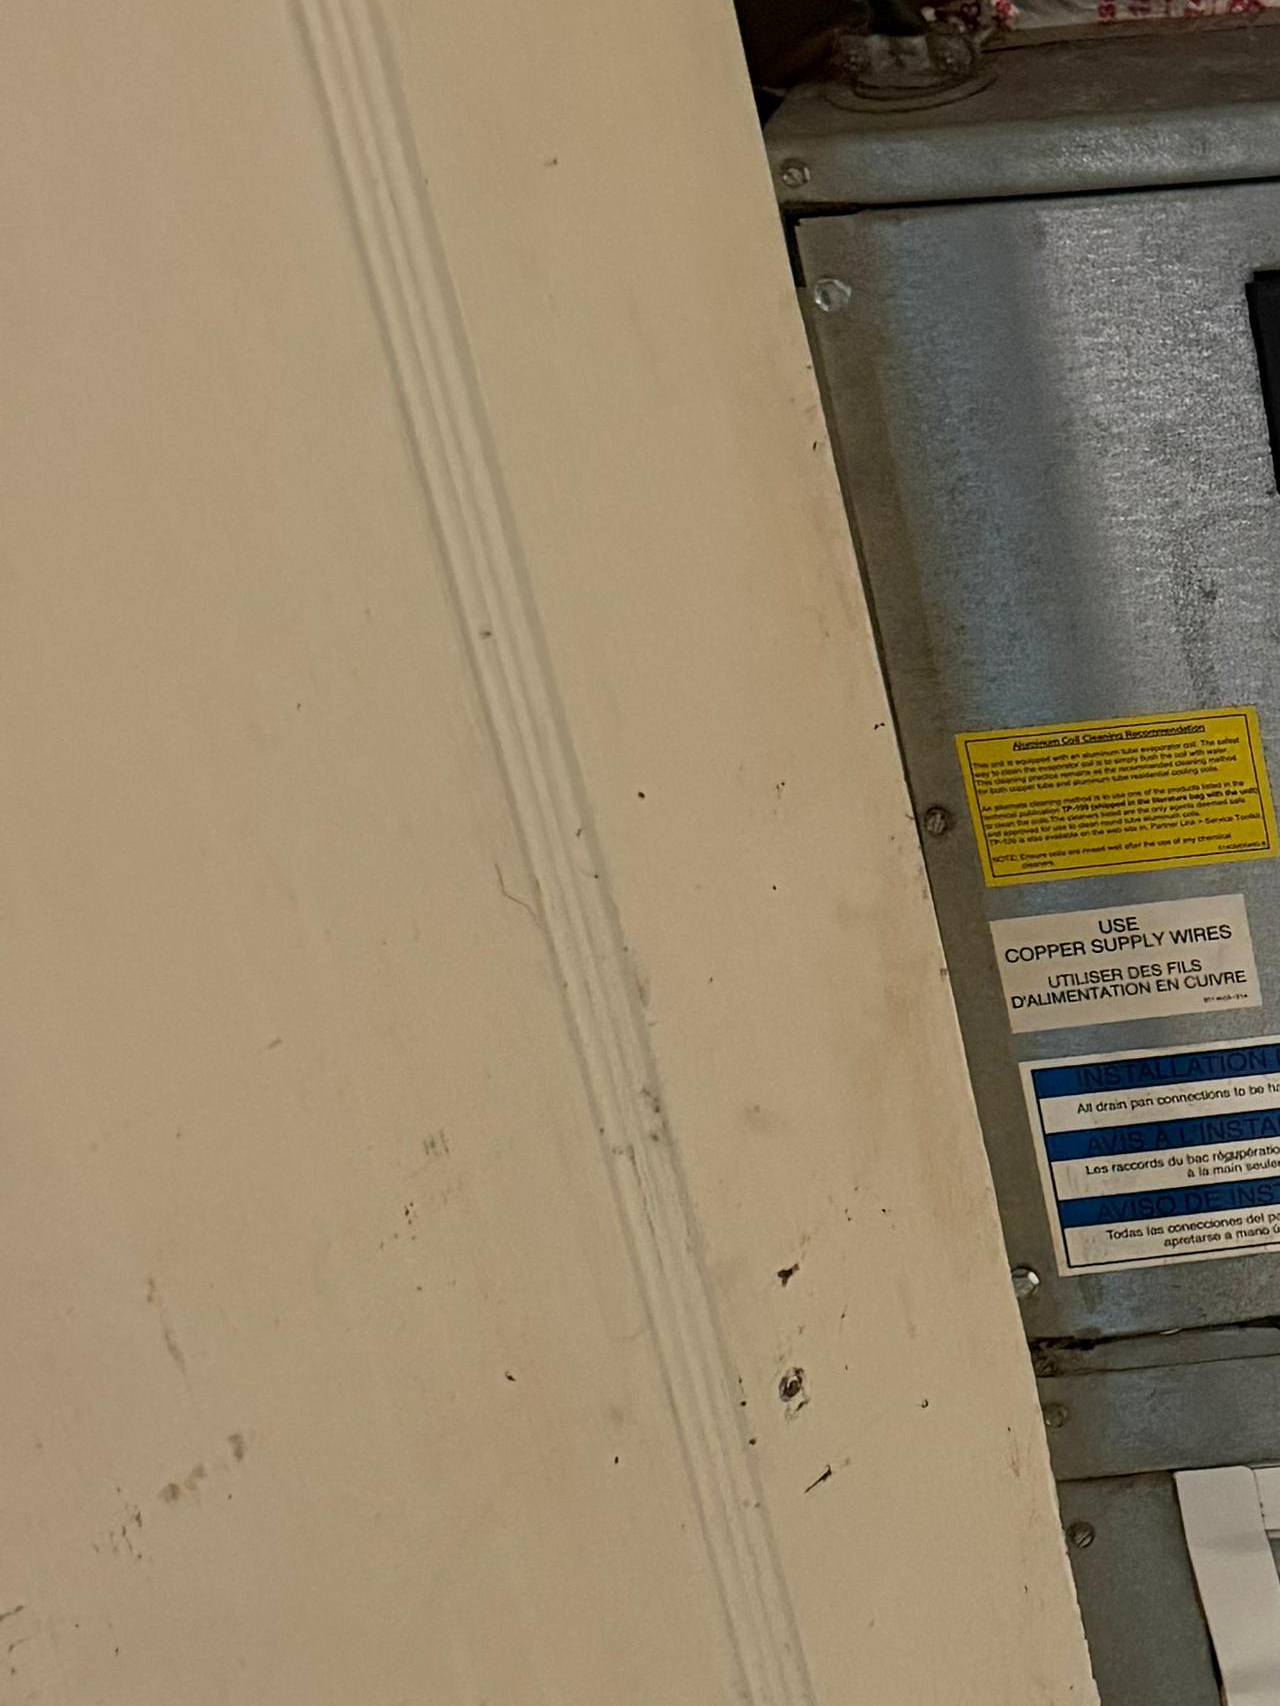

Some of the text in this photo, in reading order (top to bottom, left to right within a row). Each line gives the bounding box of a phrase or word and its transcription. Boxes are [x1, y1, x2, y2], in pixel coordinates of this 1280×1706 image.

[1097, 915, 1140, 935] USE
[1003, 923, 1232, 964] COPPER SUPPLY WIRES
[1046, 958, 1202, 989] UTILISER DES FILS
[1009, 969, 1247, 1010] D'ALIMENTATION EN CUIVRE
[1073, 1046, 1269, 1090] INSTALLATION
[1094, 1099, 1128, 1113] drain
[1129, 1096, 1154, 1111] pan
[1155, 1088, 1231, 1106] connections
[1232, 1086, 1246, 1097] to
[1247, 1084, 1265, 1095] be
[1084, 1127, 1146, 1157] AVIS
[1083, 1164, 1109, 1176] Les
[1110, 1157, 1165, 1173] raccords
[1166, 1155, 1184, 1167] du
[1185, 1152, 1210, 1165] bac
[1197, 1165, 1210, 1177] la
[1211, 1162, 1243, 1175] main
[1094, 1192, 1179, 1224] AVISO
[1181, 1186, 1224, 1214] DE
[1244, 1211, 1265, 1224] del
[1234, 1225, 1271, 1239] mano
